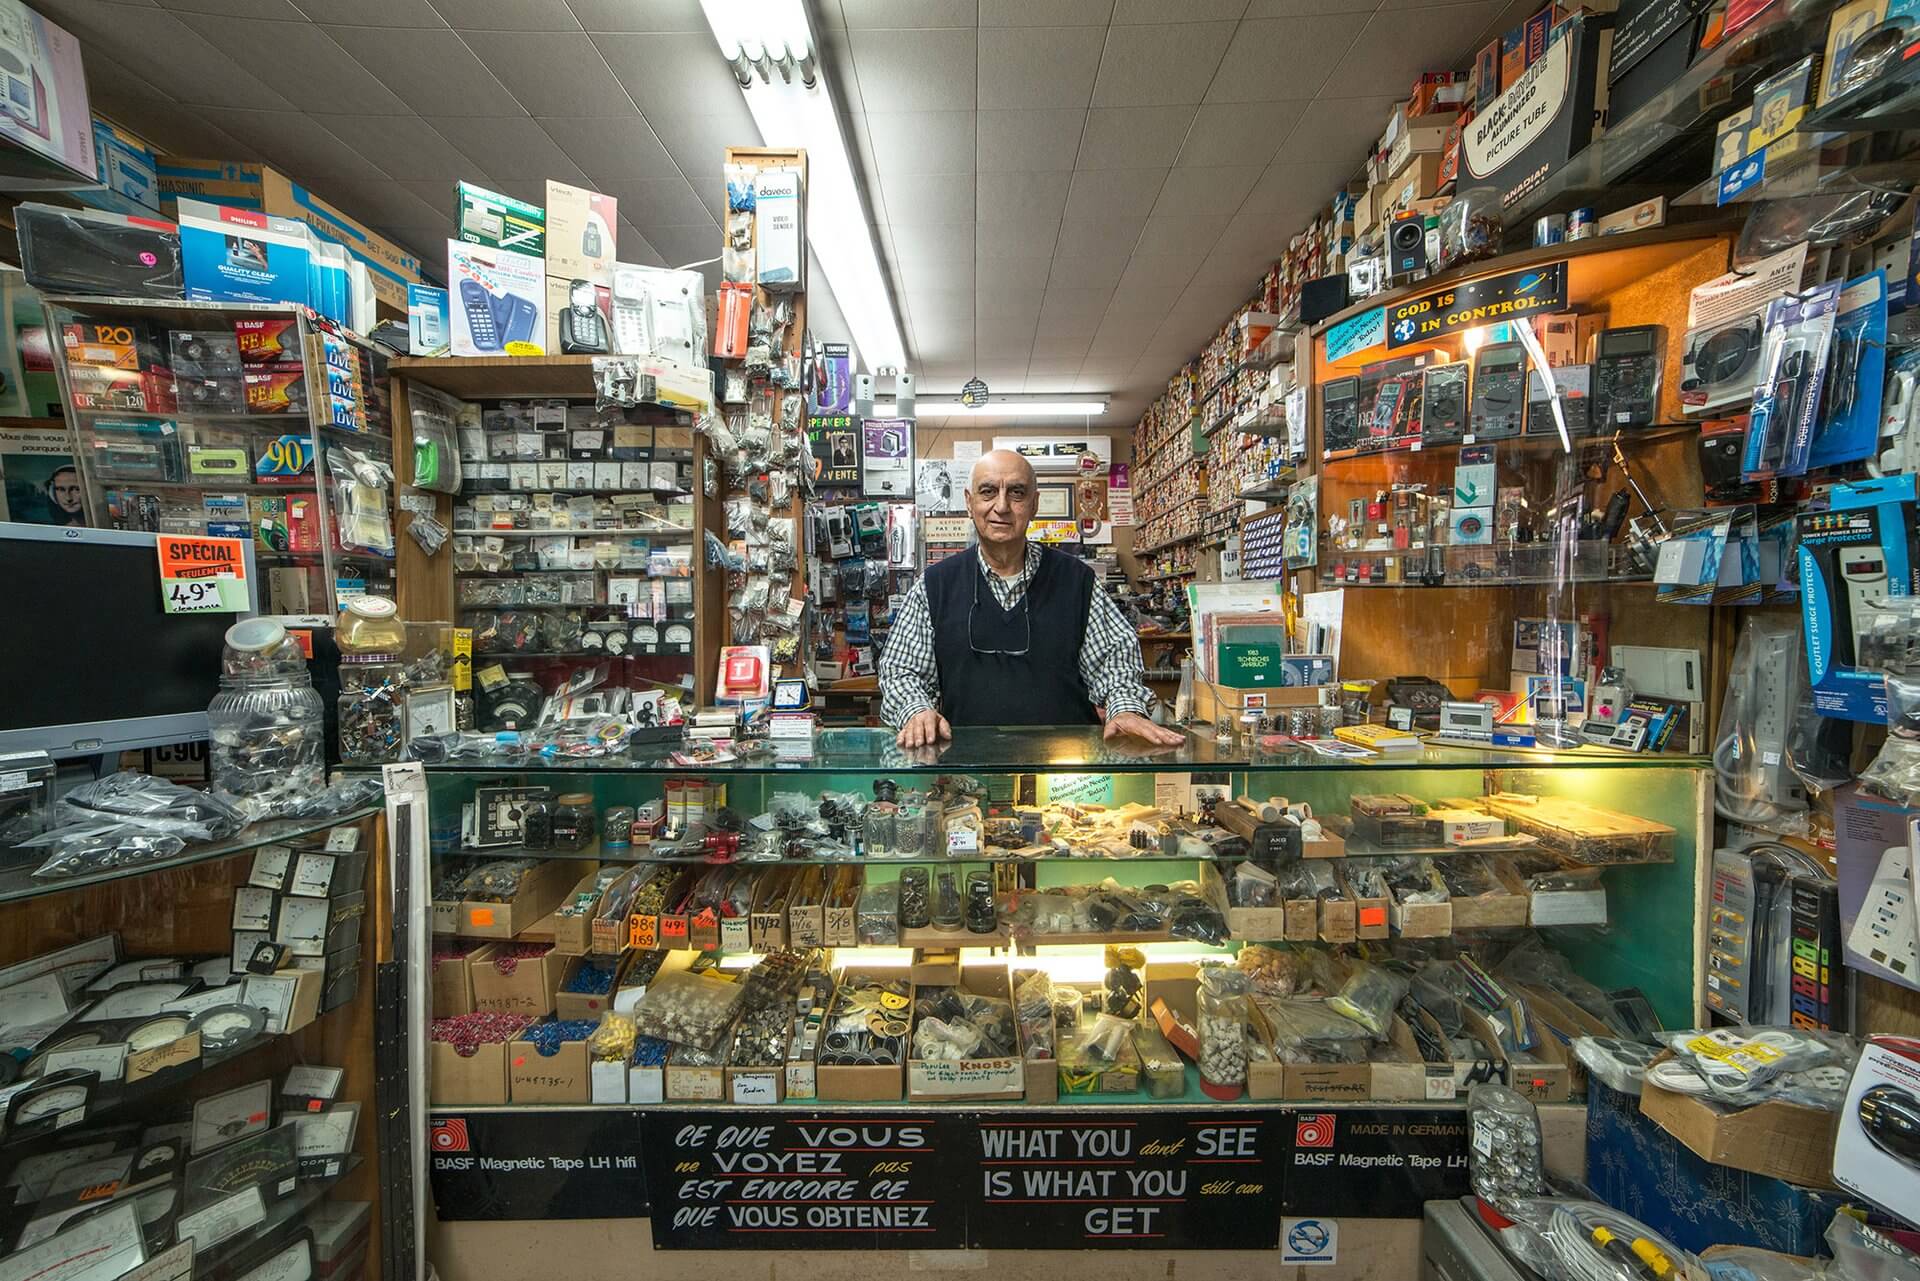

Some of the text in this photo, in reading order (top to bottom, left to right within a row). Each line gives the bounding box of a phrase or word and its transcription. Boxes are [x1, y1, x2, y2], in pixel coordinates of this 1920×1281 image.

[1491, 86, 1536, 142] ALUMINIZED
[1486, 101, 1548, 162] PICTURE TUBE
[760, 186, 792, 196] daveco
[1504, 163, 1550, 203] ANADIAN
[230, 215, 258, 227] PHILIPS
[306, 211, 352, 247] ALPHASONIC
[217, 264, 250, 275] QUALITY
[250, 270, 275, 280] CLEAN
[1770, 265, 1786, 277] ANT
[1396, 293, 1455, 319] GOD IS
[95, 325, 133, 345] 120
[244, 321, 264, 329] BASF
[1358, 322, 1380, 342] Today!
[1420, 318, 1441, 333] IN
[74, 393, 144, 408] UR 120
[44, 434, 65, 442] vous
[22, 444, 61, 453] pourquoi
[267, 440, 303, 472] 90
[1769, 477, 1778, 504] ENCO
[1802, 532, 1873, 546] Surge Protector
[1829, 529, 1851, 537] POWER
[169, 541, 236, 561] SPÉCIAL
[1804, 554, 1816, 608] PROTECTOR
[1810, 608, 1818, 636] SURGE
[1087, 783, 1109, 797] Today!
[1089, 774, 1111, 786] Needle
[630, 917, 655, 933] 98¢
[752, 916, 781, 938] 19/32
[960, 1060, 1012, 1071] KNOBS
[675, 1125, 925, 1150] CE QUE VOUS
[1350, 1124, 1388, 1136] MADE
[1392, 1124, 1404, 1135] IN
[980, 1127, 1257, 1157] WHAT YOU don't SEE
[434, 1156, 637, 1171] BASF Magnetic Tape LH hifi
[674, 1152, 912, 1177] ne VOYEZ pas
[1294, 1153, 1468, 1169] BASF Magnetic Tape LH
[678, 1179, 909, 1200] EST ENCORE CE
[984, 1170, 1265, 1197] IS WHAT YOU still can
[672, 1206, 929, 1231] QUE VOUS OBTENEZ
[1084, 1207, 1161, 1234] GET
